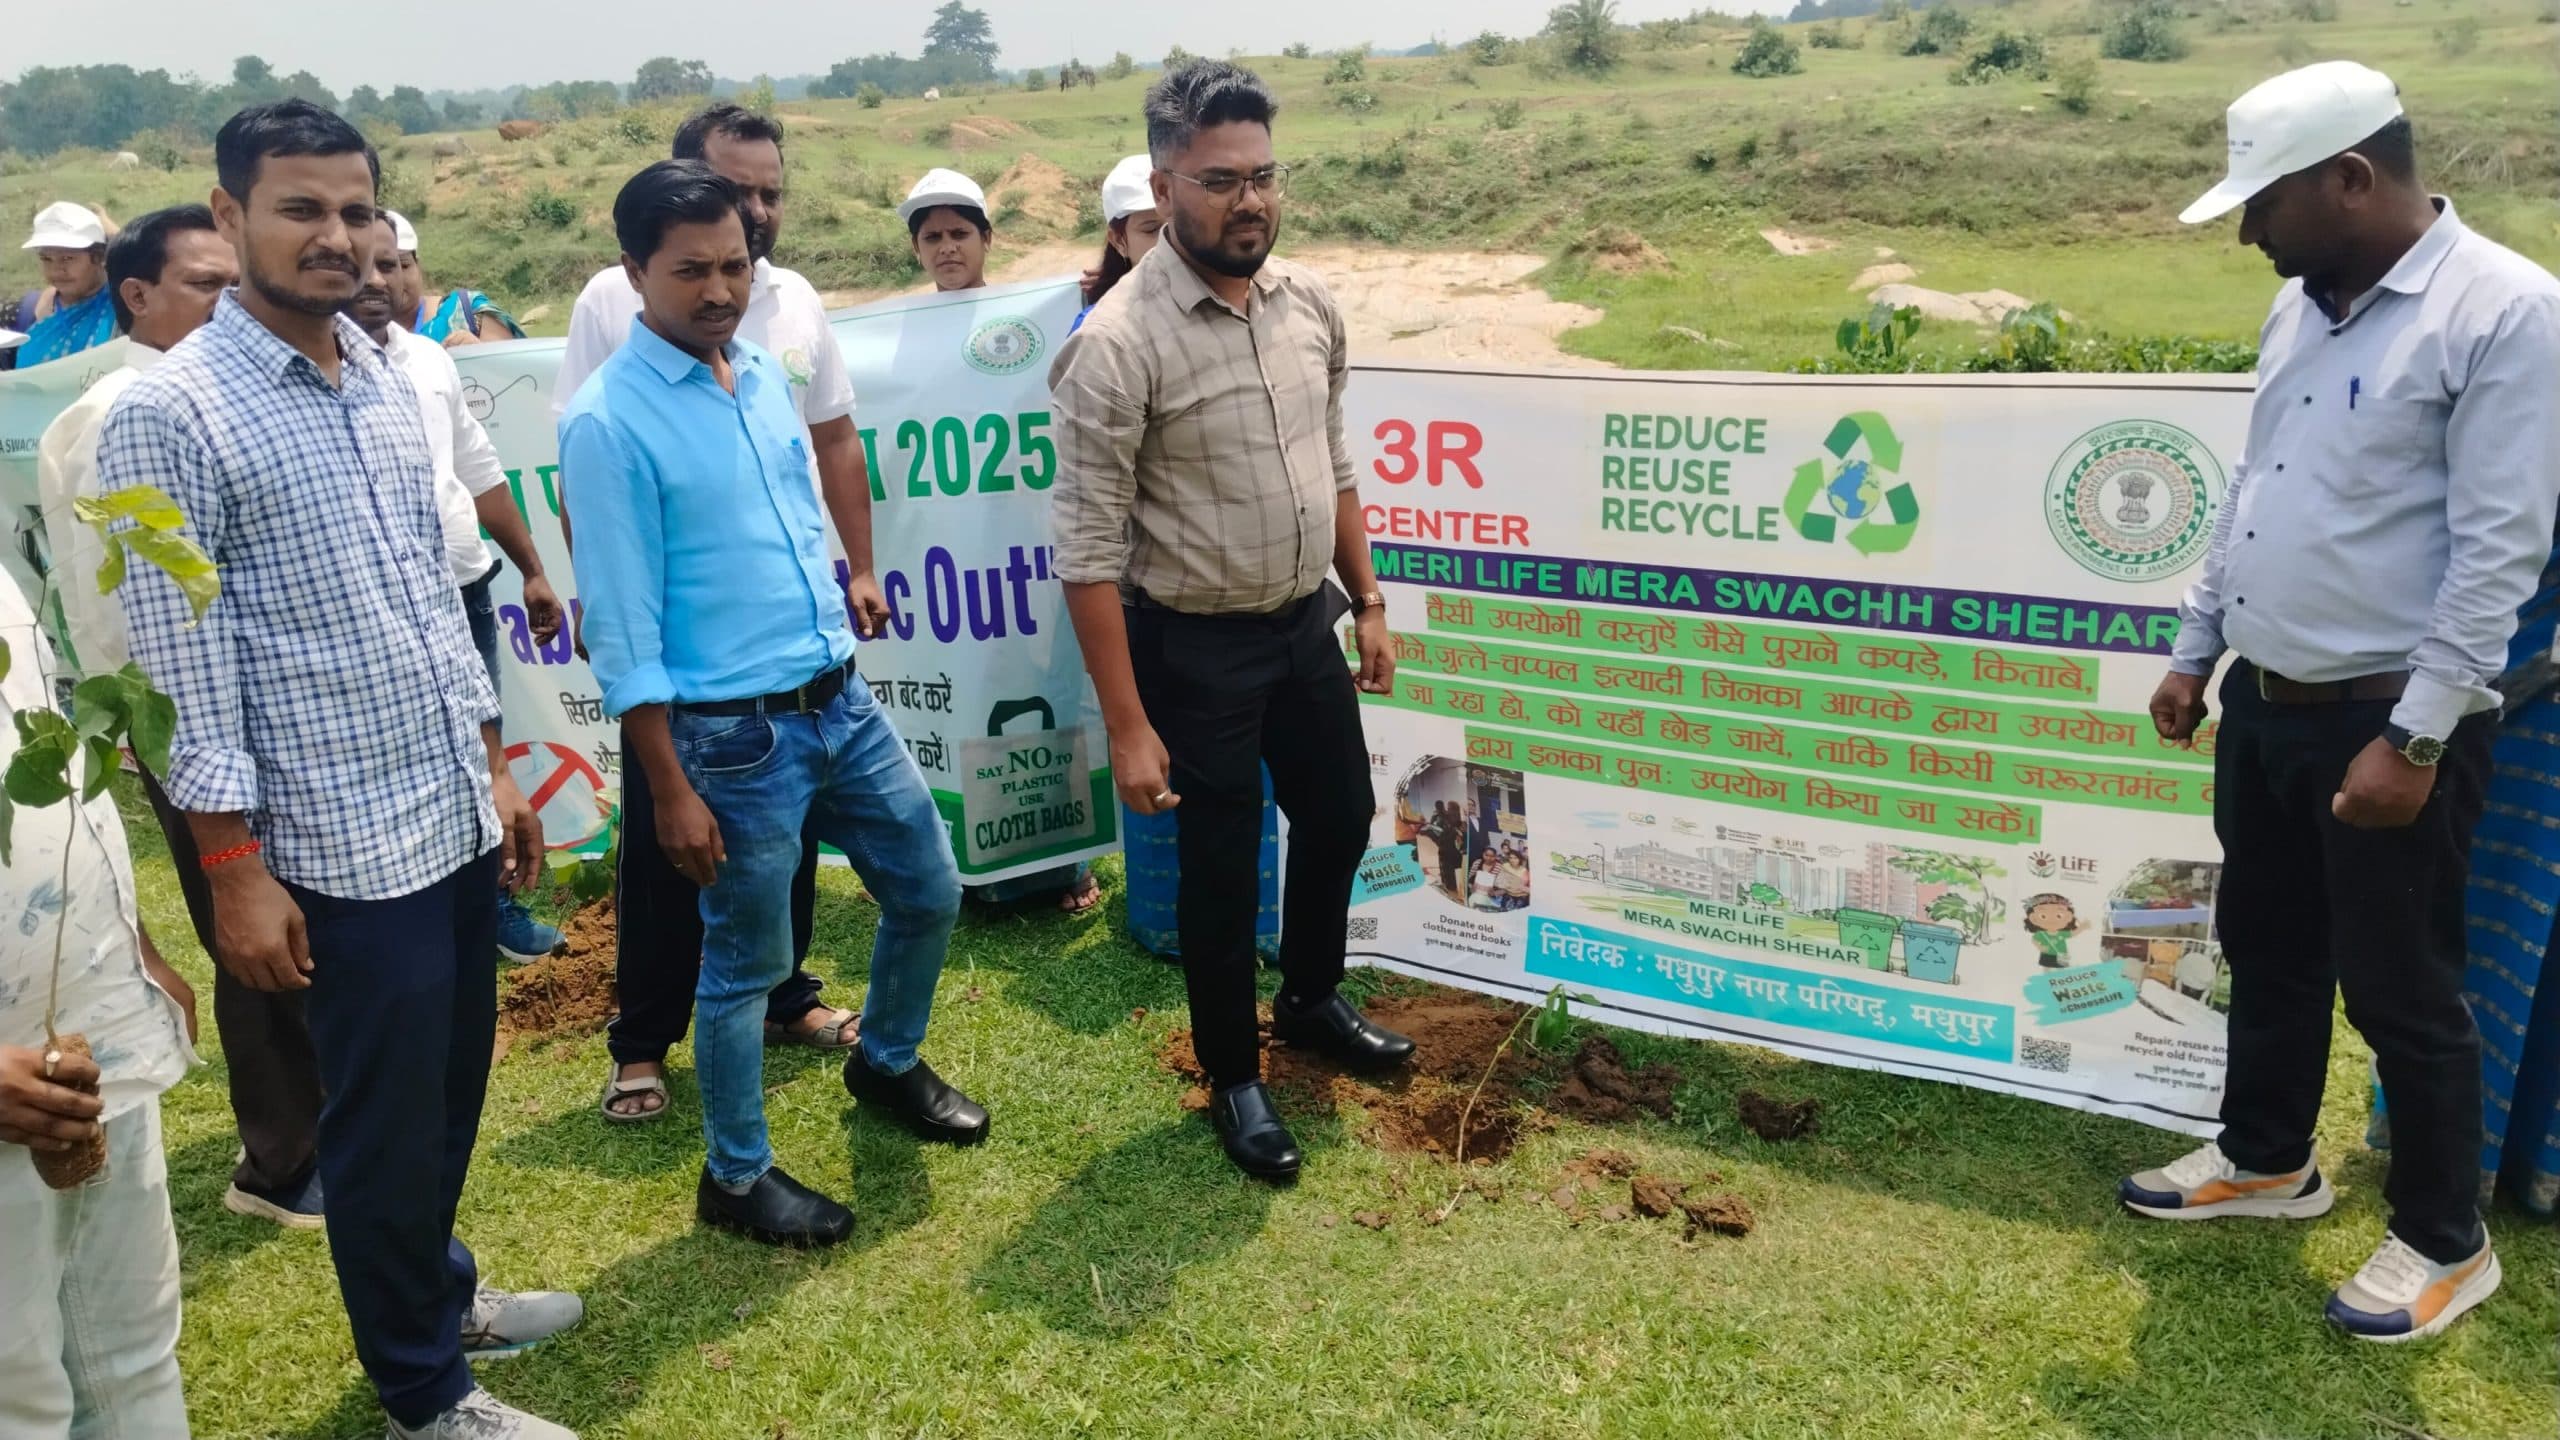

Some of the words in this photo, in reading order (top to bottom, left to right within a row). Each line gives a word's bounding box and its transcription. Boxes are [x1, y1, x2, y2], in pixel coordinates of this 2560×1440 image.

[1373, 418, 1484, 490] 3R
[1603, 413, 1767, 454] REDUCE
[897, 413, 1057, 498] 2025
[1602, 455, 1731, 496] REUSE
[1362, 504, 1530, 546] CENTER
[1602, 497, 1779, 542] RECYCLE
[2053, 508, 2122, 574] GOVERNMENT
[2124, 565, 2142, 576] OF
[2144, 518, 2214, 575] JHARKHAND
[1372, 547, 1462, 585] MERI
[1475, 557, 1562, 593] LIFE
[1576, 565, 1700, 606] MERA
[1714, 578, 1932, 627] SWACHH
[1951, 598, 2181, 649] SHEHAR
[1426, 594, 1475, 627] वैसी
[1488, 604, 1582, 638] उपयोगी
[1693, 621, 1748, 655] जैसे
[1762, 632, 1841, 669] पुराने
[898, 675, 922, 711] बंद
[922, 672, 952, 714] करें
[1592, 664, 1685, 696] इत्यादी
[1701, 669, 1804, 711] जिनका
[1820, 690, 1915, 723] आपके
[1931, 704, 2001, 734] द्वारा
[2018, 710, 2139, 748] उपयोग
[976, 765, 1004, 780] SAY
[1008, 746, 1052, 773] NO
[1056, 753, 1073, 766] TO
[1405, 683, 1436, 705] जा
[1447, 689, 1486, 714] रहा
[1546, 697, 1583, 729] को
[1660, 711, 1713, 749] छोड़
[1815, 736, 1891, 769] ताकि
[1908, 743, 1996, 784] किसी
[2013, 764, 2182, 804] जरूरतमंद
[1001, 772, 1064, 795] PLASTIC
[1018, 792, 1045, 807] USE
[1465, 734, 1514, 760] द्वारा
[1527, 744, 1604, 775] इनका
[1690, 767, 1790, 804] उपयोग
[1805, 777, 1882, 818] किया
[1897, 799, 1940, 825] जा
[975, 810, 1037, 851] CLOTH
[1041, 799, 1085, 833] BAGS
[1359, 863, 1404, 884] Waste
[1360, 851, 1395, 868] educe
[2061, 855, 2099, 873] LiFE
[1422, 921, 1457, 936] clothes
[1458, 929, 1479, 941] and
[1480, 932, 1512, 947] books
[1439, 914, 1476, 930] Donate
[1477, 923, 1494, 934] old
[1624, 908, 1676, 932] MERA
[1680, 920, 1768, 949] SWACHH
[1773, 938, 1861, 965] SHEHAR
[1688, 901, 1738, 922] MERI
[1743, 912, 1786, 931] LiFE
[1540, 922, 1628, 969] निवेदक
[1655, 953, 1728, 999] मधुपुर
[1733, 972, 1791, 1006] नगर
[1910, 1003, 1998, 1047] मधुपुर
[2048, 970, 2097, 988] Reduce
[2053, 981, 2107, 1003] Waste
[2124, 1043, 2164, 1057] recycle
[2166, 1050, 2187, 1061] old
[2188, 1052, 2227, 1068] furnitu
[2134, 1031, 2175, 1048] Repair,
[2177, 1038, 2211, 1053] reuse
[2212, 1045, 2228, 1055] an
